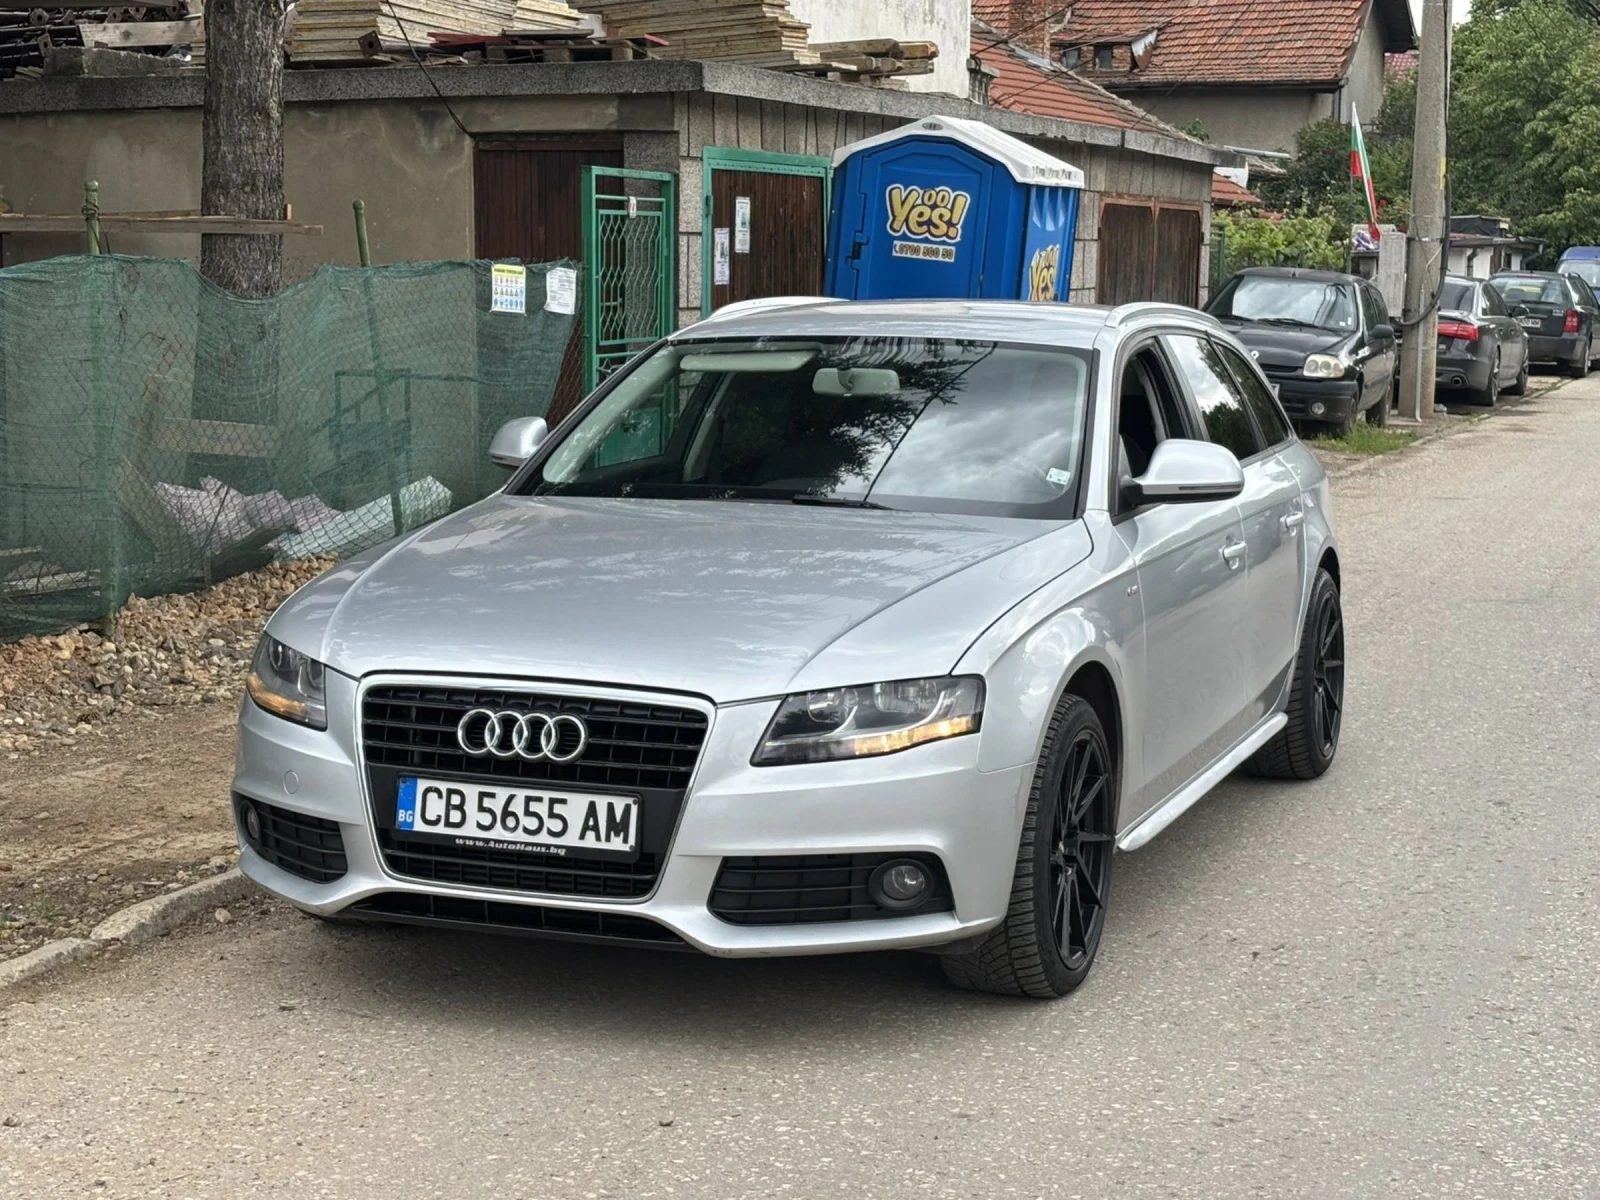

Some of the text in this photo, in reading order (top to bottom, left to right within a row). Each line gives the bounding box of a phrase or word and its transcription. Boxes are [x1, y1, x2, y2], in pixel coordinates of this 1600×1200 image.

[887, 187, 968, 240] Yes!
[898, 243, 954, 260] 0700 500 50
[398, 809, 414, 823] BG
[420, 786, 632, 844] CB 5655 AM
[455, 838, 567, 856] www.AutoHaus.bg
